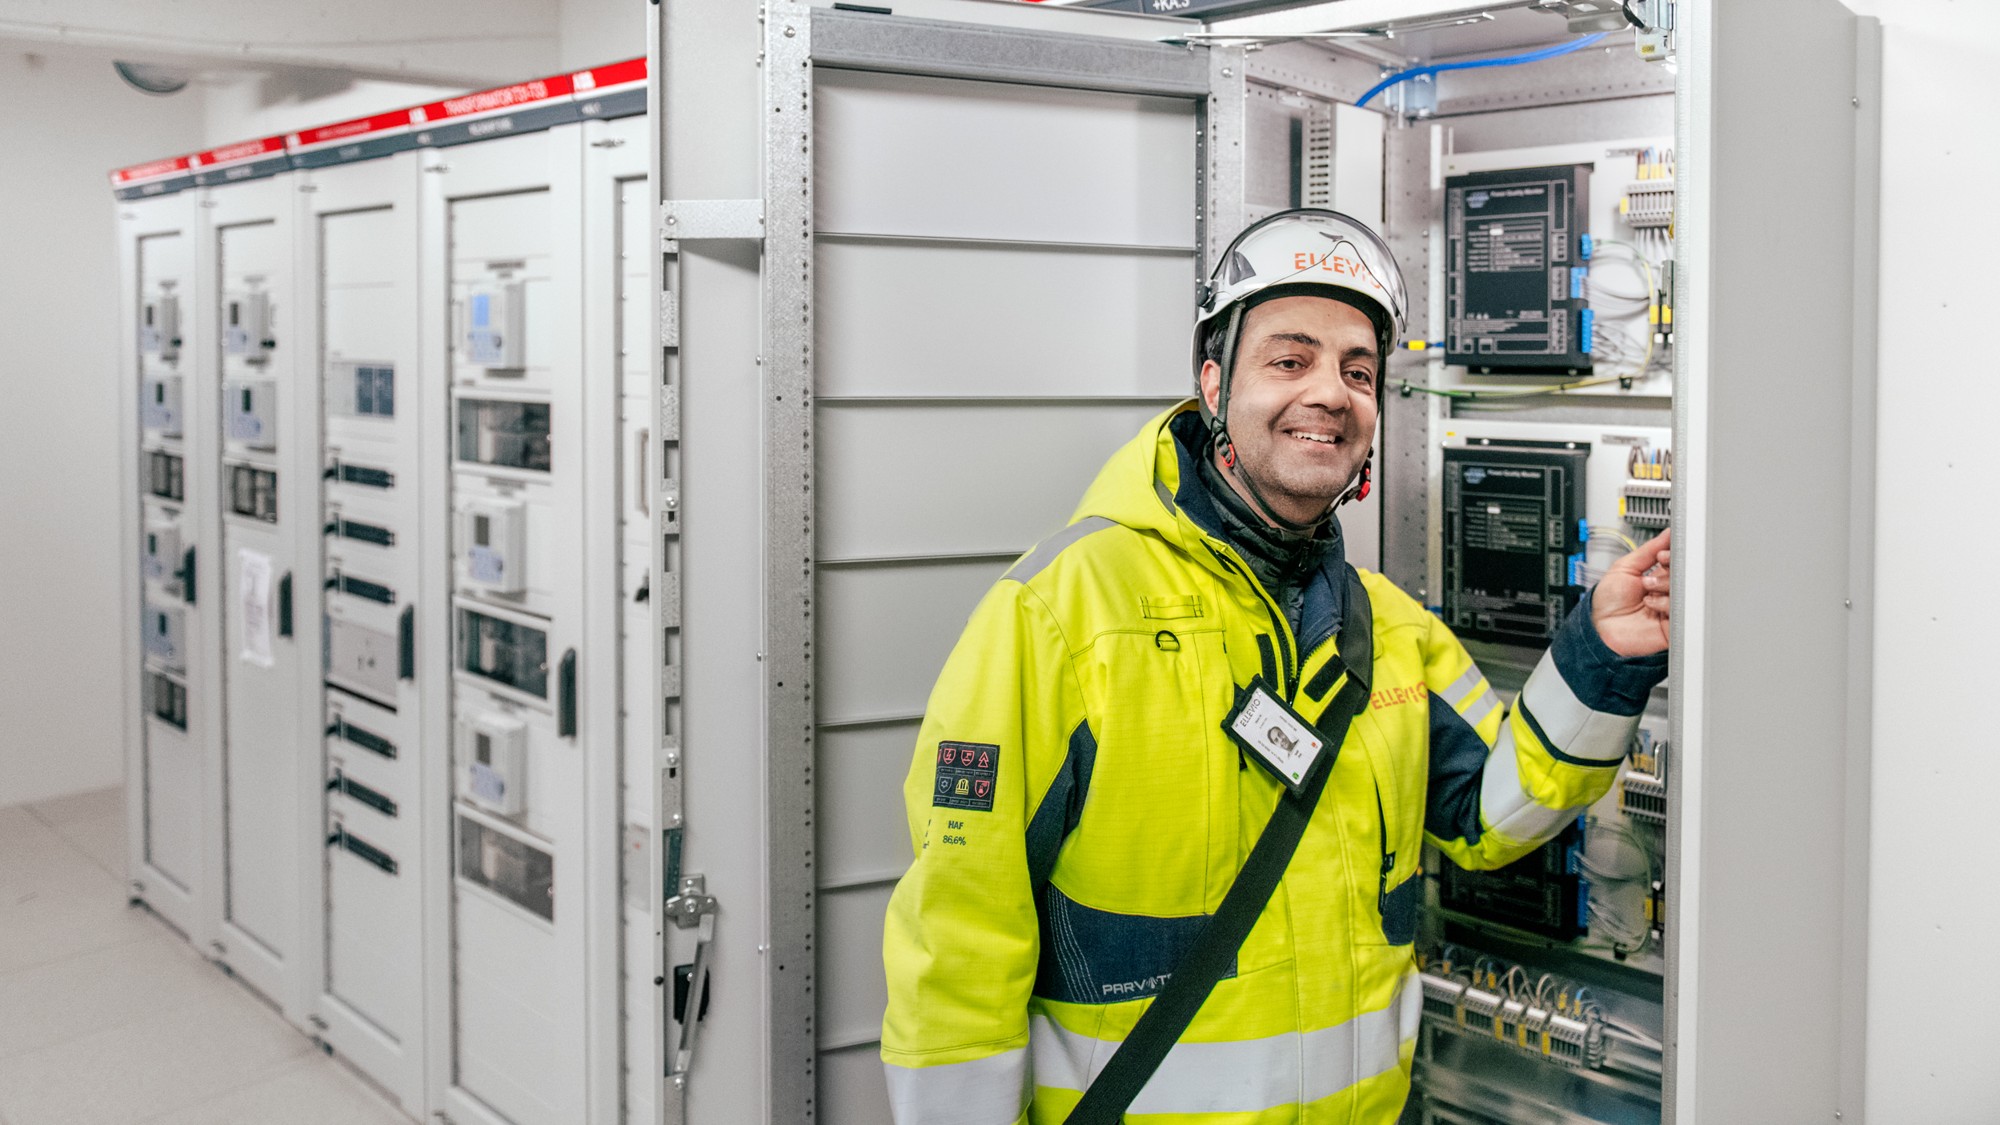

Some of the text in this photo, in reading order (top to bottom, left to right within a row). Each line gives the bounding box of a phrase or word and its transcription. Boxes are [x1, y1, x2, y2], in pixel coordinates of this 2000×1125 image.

[1370, 681, 1428, 710] ELLEVIO
[1239, 698, 1261, 728] ELLEVIO
[948, 820, 964, 830] HAF
[942, 834, 967, 846] 86,6%
